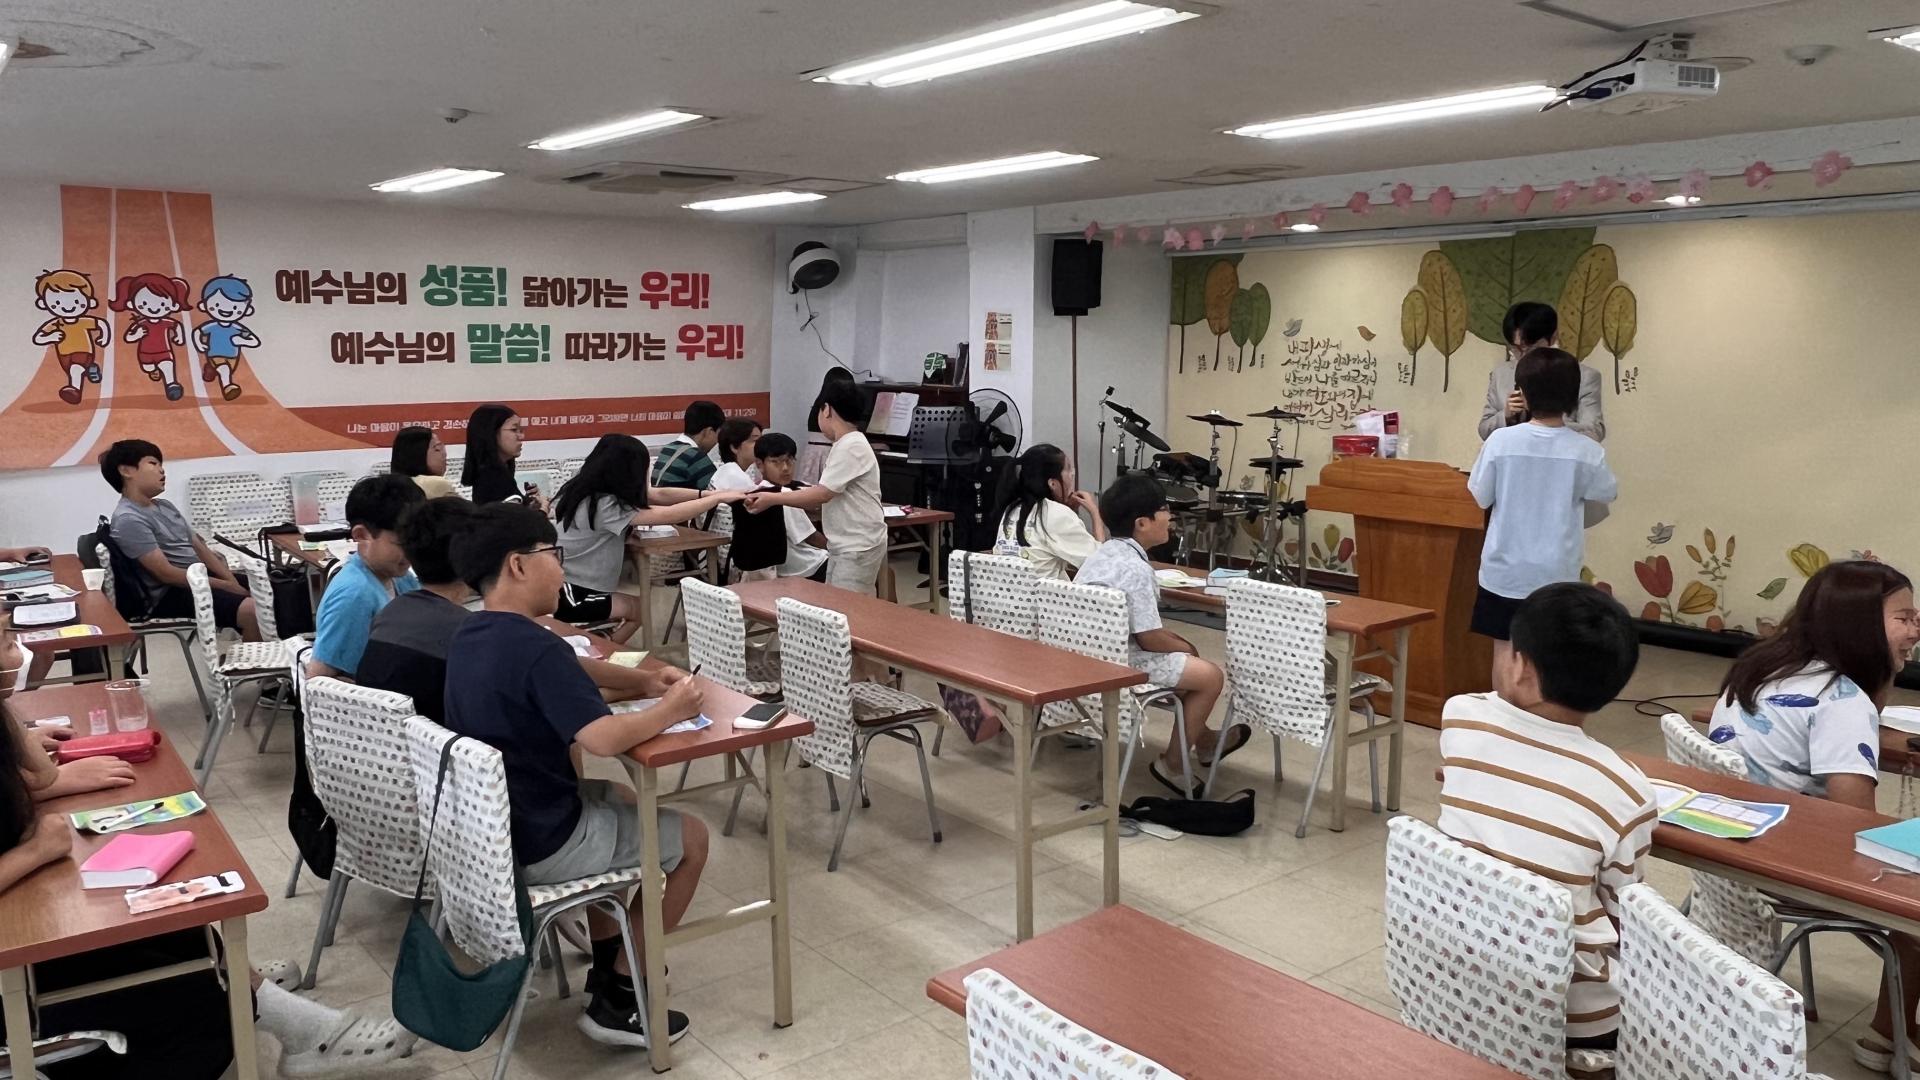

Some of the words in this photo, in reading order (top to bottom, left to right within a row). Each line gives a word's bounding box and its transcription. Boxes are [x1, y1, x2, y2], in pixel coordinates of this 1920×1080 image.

[275, 269, 407, 306] 예수님의
[420, 264, 508, 307] 성품!
[523, 276, 629, 309] 닮아가는
[639, 271, 713, 309] 우리!
[331, 331, 456, 365] 예수님의
[467, 323, 551, 364] 말씀!
[565, 332, 667, 362] 따라가는
[676, 323, 745, 361] 우리!
[347, 423, 368, 434] 나는
[370, 422, 400, 433] 마음이
